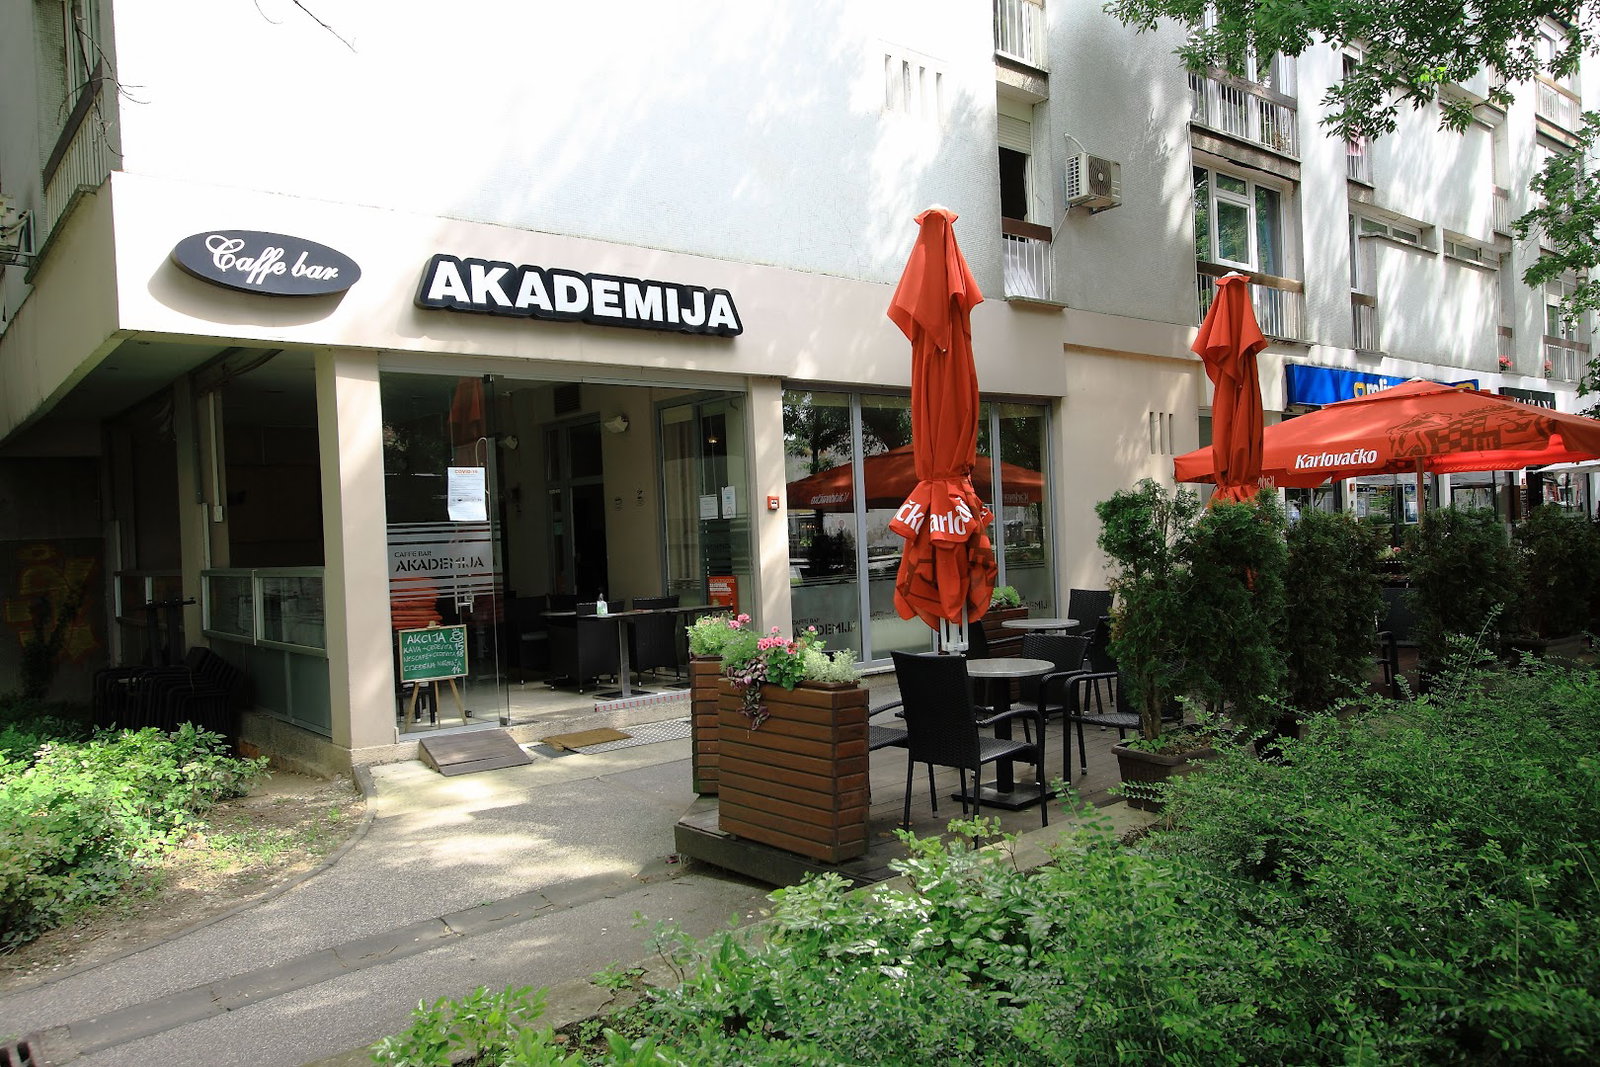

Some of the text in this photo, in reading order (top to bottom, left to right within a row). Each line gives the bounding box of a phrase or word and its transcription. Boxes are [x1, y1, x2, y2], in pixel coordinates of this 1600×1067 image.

[205, 233, 339, 287] Caffe bar
[427, 260, 738, 329] AKADEMIJA
[1295, 448, 1378, 469] Karlovačko
[406, 632, 447, 644] AKCIJA
